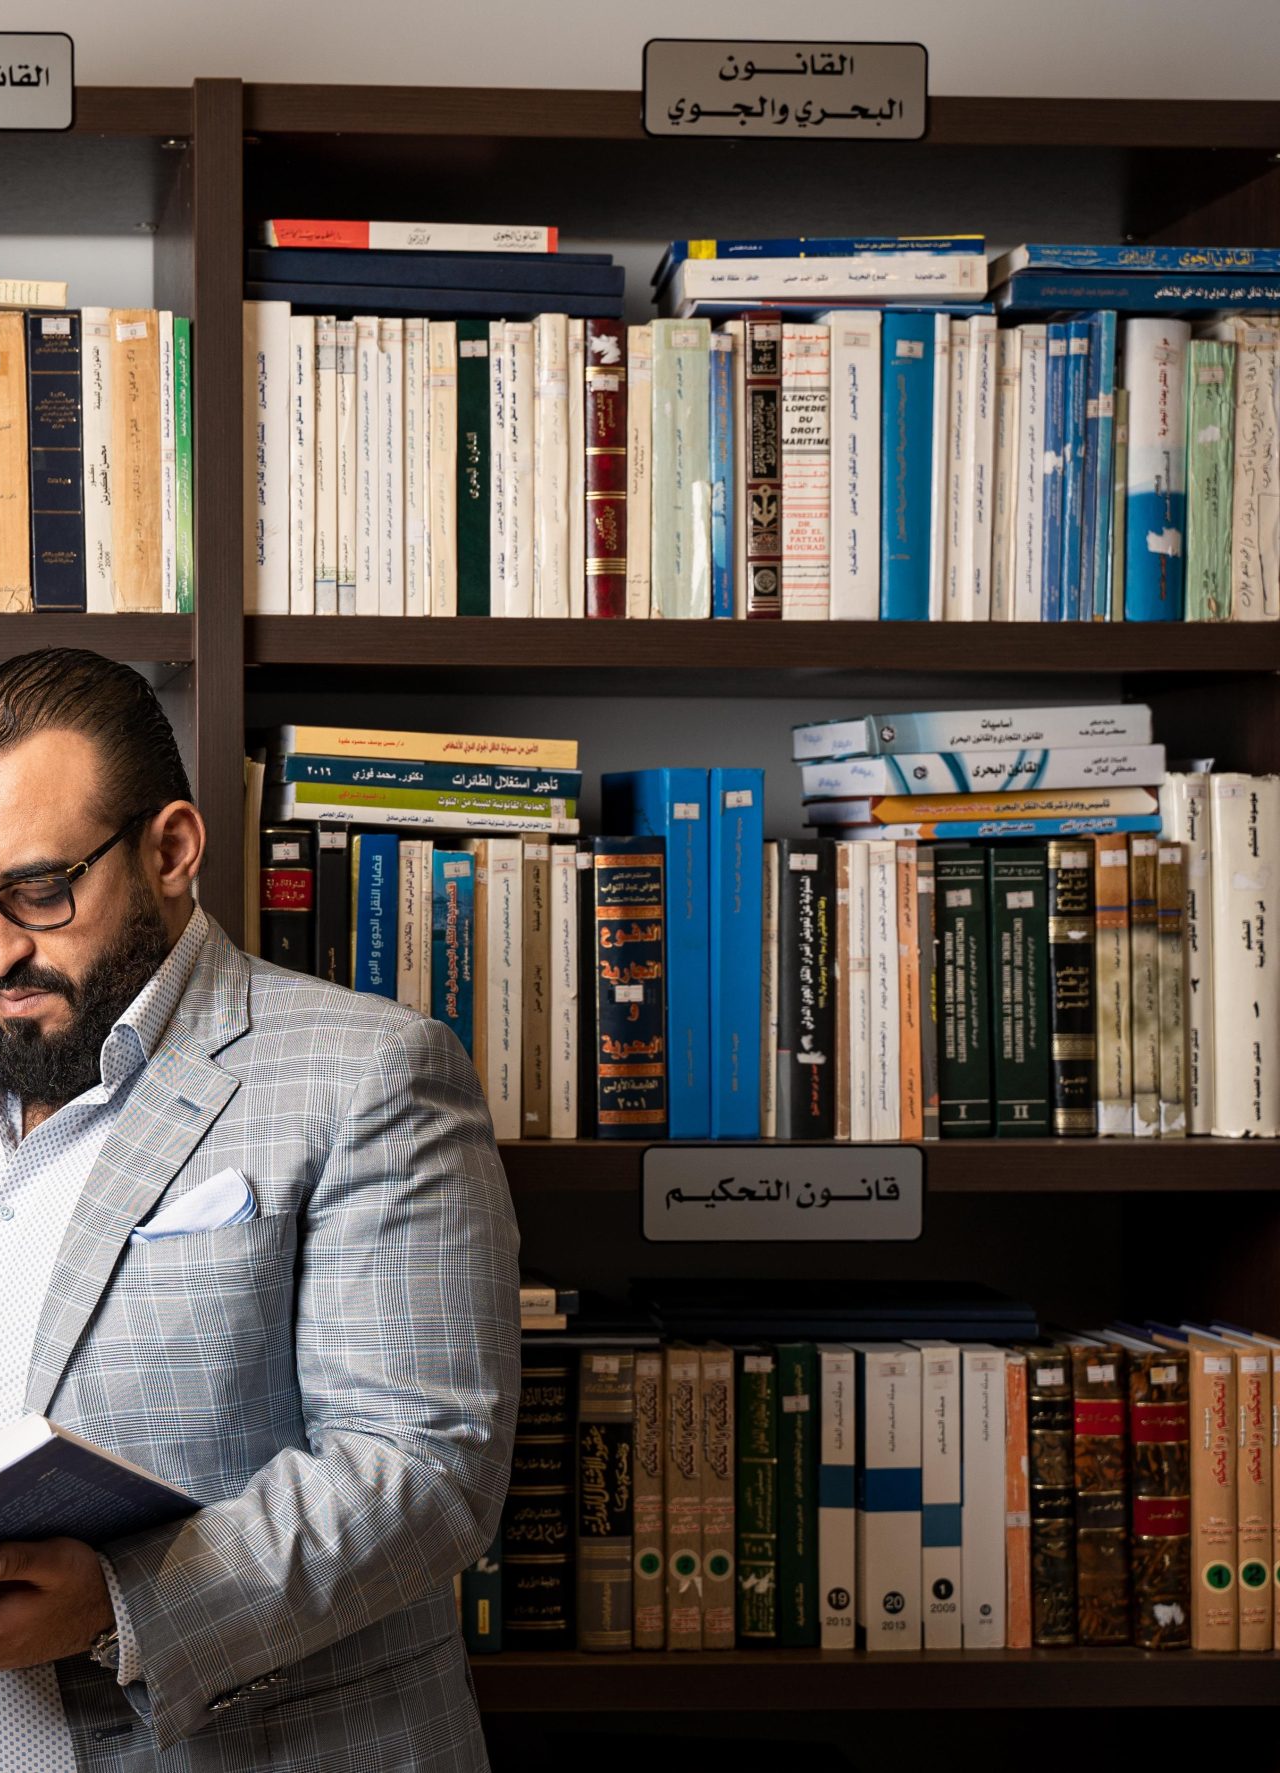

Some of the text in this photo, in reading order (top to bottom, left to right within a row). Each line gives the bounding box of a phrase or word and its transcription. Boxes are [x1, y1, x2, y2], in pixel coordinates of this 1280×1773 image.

[719, 53, 855, 82] القانون
[790, 427, 822, 435] DROIT
[664, 1176, 901, 1210] قانون التحكيم
[939, 1583, 947, 1595] 1
[830, 1591, 848, 1605] 19
[885, 1597, 903, 1609] 20
[930, 1603, 956, 1614] 2009
[826, 1616, 852, 1627] 2013
[881, 1620, 906, 1631] 2013
